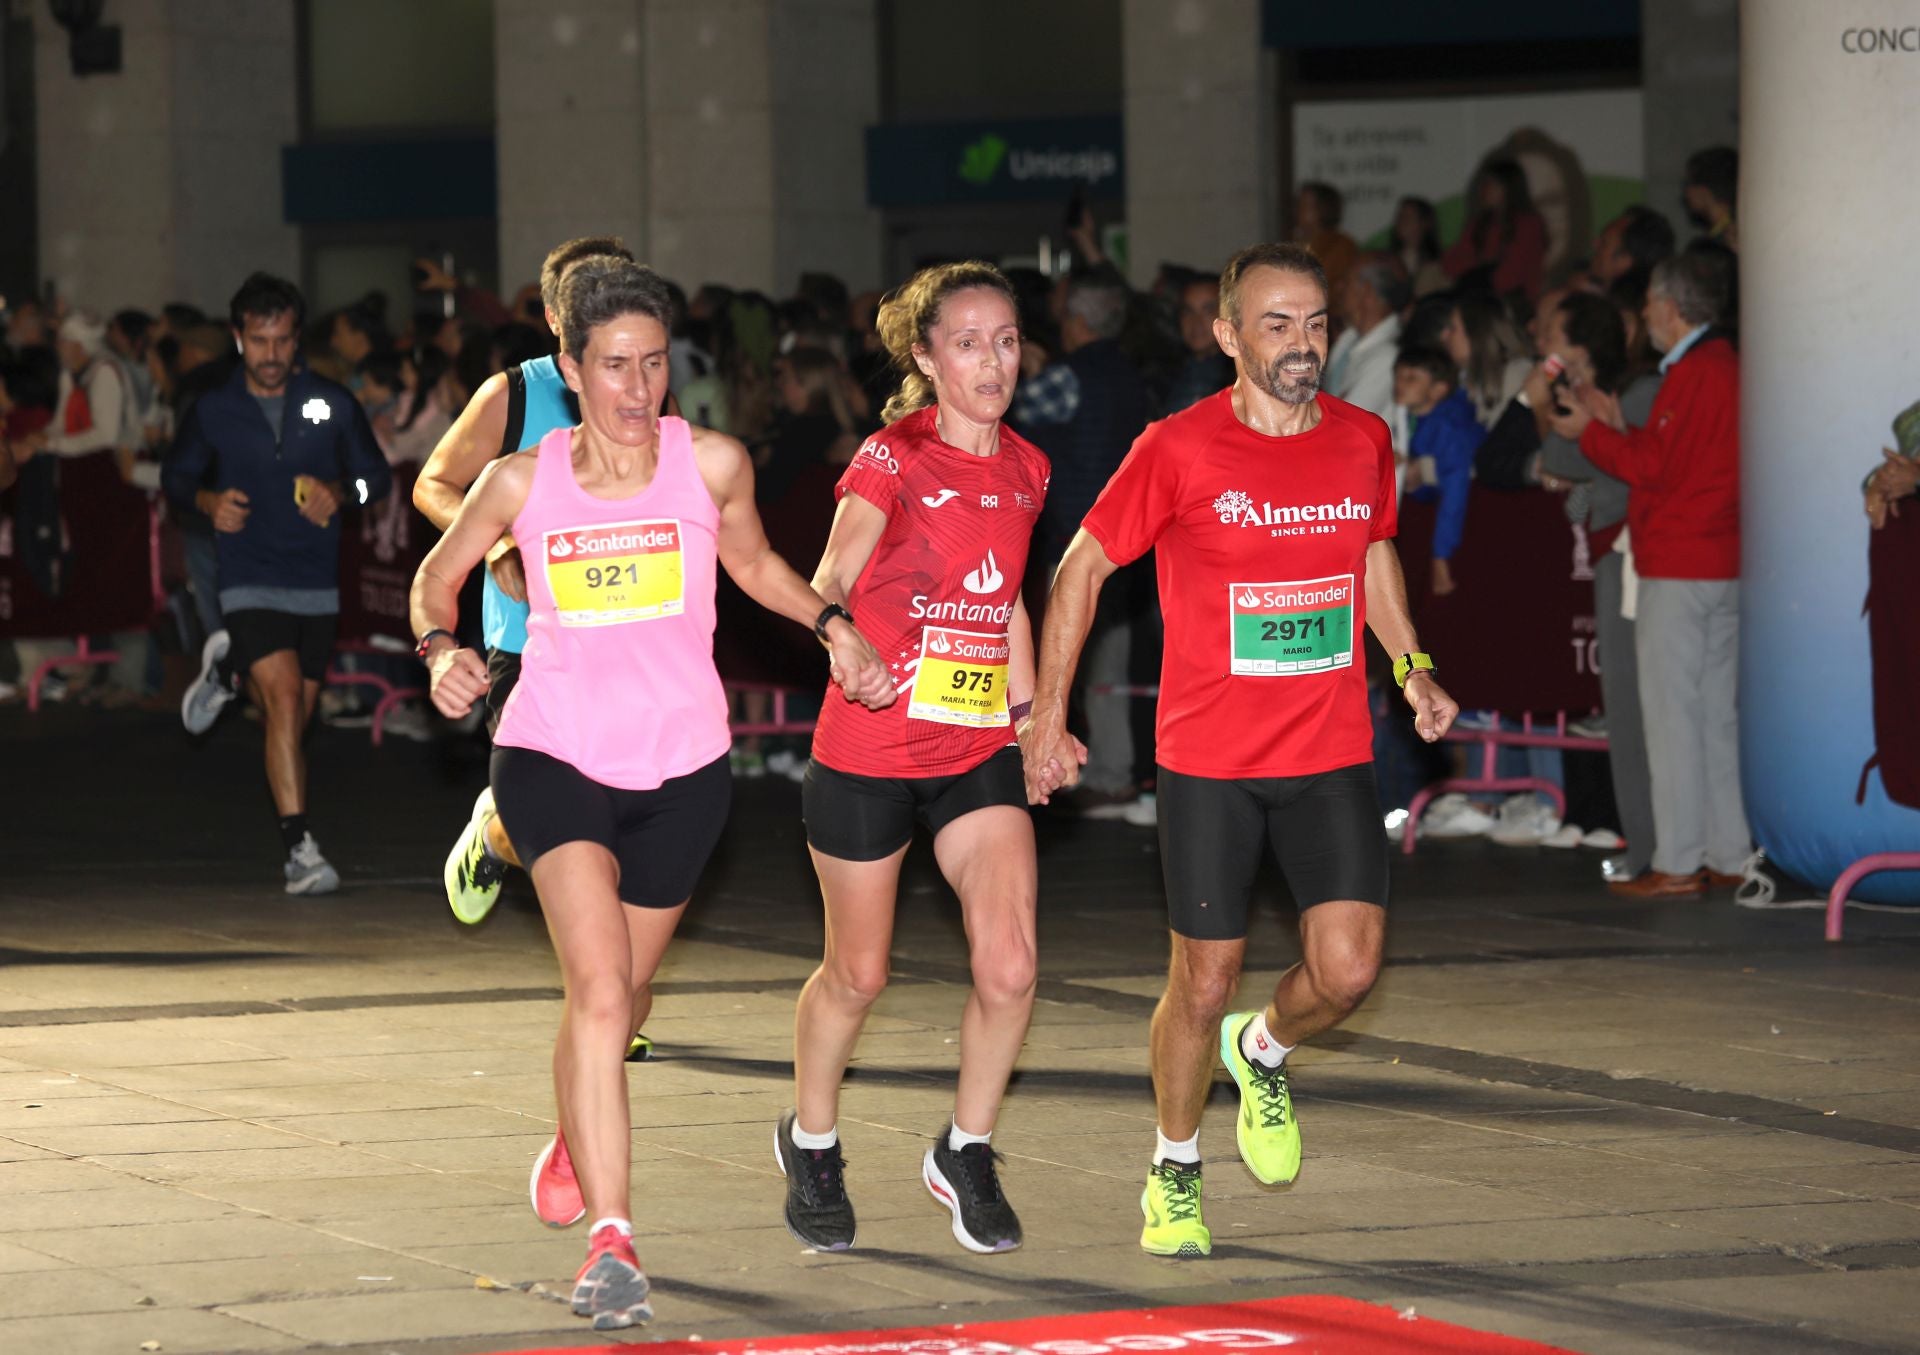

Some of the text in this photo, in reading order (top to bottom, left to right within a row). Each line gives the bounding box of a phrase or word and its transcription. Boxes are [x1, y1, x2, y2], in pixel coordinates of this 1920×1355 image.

[1008, 146, 1117, 184] Unicaja
[1240, 497, 1371, 528] Almendro
[574, 529, 675, 555] Santander
[1271, 525, 1337, 537] SINCE 1883
[585, 563, 638, 589] 921
[1263, 585, 1348, 608] Santander
[908, 595, 1014, 624] Santande
[1261, 616, 1326, 641] 2971
[952, 639, 1009, 659] Santander
[1283, 646, 1313, 655] MARIO
[951, 669, 994, 693] 975
[940, 695, 992, 707] MARIA TERESA
